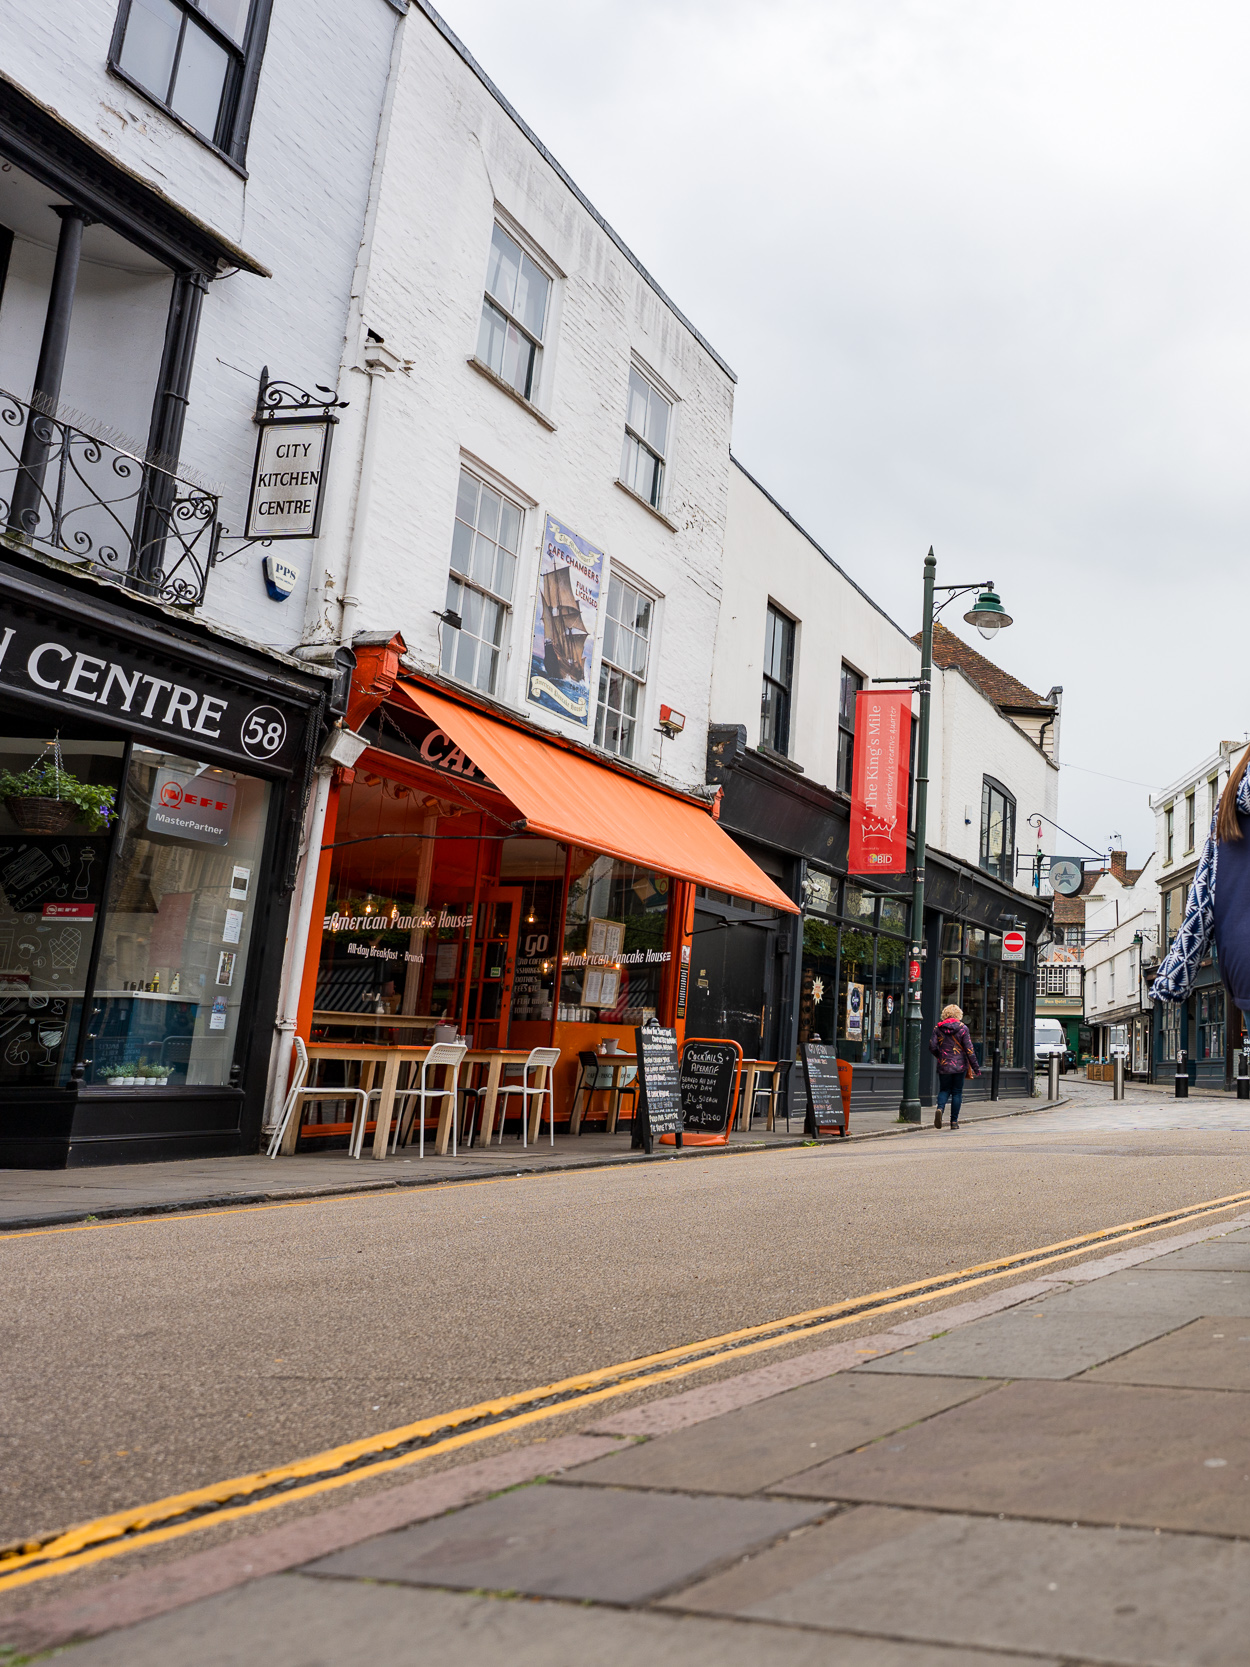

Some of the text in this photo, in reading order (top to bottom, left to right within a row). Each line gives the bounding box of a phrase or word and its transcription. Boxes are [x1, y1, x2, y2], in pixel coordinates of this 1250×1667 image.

[276, 443, 312, 459] CITY
[257, 470, 320, 488] KITCHEN
[258, 499, 312, 516] CENTRE
[275, 563, 297, 581] PPS
[548, 542, 599, 584] CAFE CHAMBERS
[575, 588, 598, 608] LICENSED
[28, 642, 228, 739] CENTRE
[244, 716, 282, 750] 58
[865, 705, 883, 811] The King's Mile
[155, 813, 223, 834] MasterPartner
[877, 855, 893, 864] BID
[328, 910, 467, 931] American Pancake House
[370, 945, 398, 961] Breakfast
[404, 951, 424, 964] Brunch
[568, 949, 667, 966] American Pancake House
[687, 1050, 724, 1063] COCKTAILS
